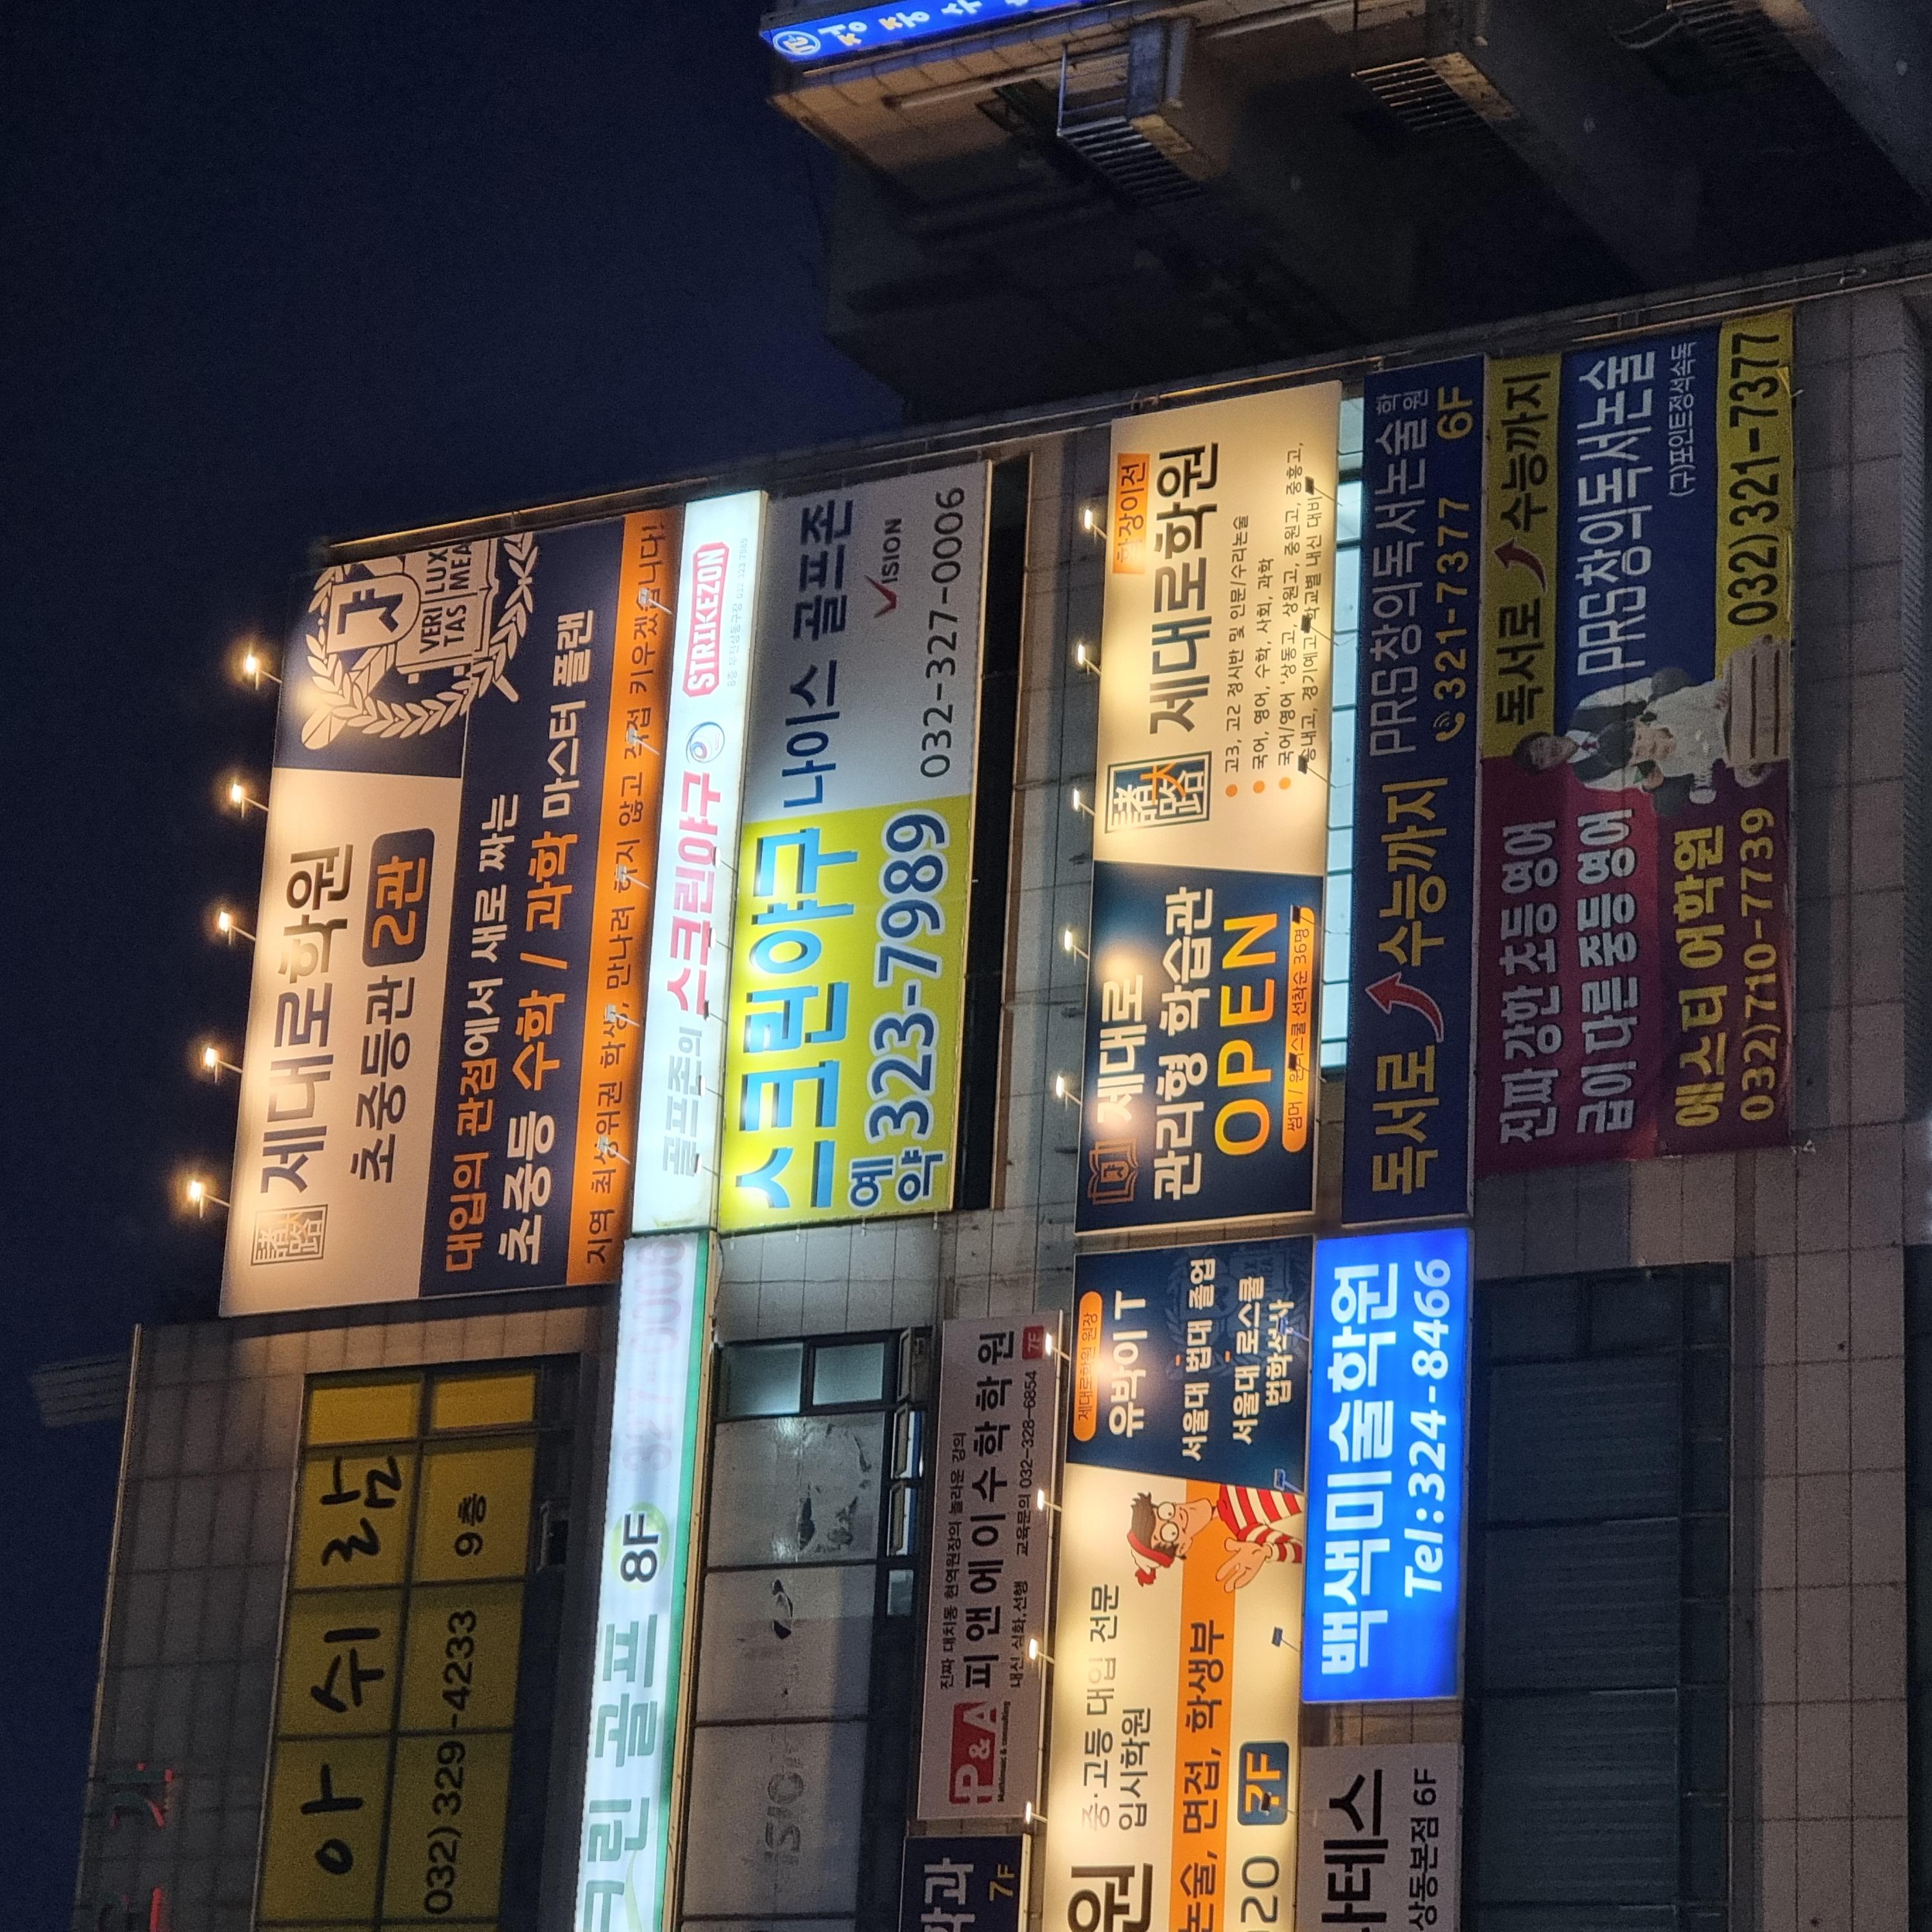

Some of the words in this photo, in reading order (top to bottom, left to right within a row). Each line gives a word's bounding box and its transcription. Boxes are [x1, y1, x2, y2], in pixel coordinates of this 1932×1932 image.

[1437, 386, 1474, 439] 6F
[1499, 371, 1550, 532] 수능까지
[1727, 333, 1781, 627] 032)321-7377
[1305, 534, 1323, 566] 내신
[1306, 495, 1324, 528] 대비
[1575, 351, 1656, 676] PRS창의독서논술
[424, 546, 448, 595] LUX
[451, 542, 473, 591] MEA
[792, 500, 853, 641] 골프존
[1147, 442, 1218, 735] 제대로학원
[1229, 515, 1249, 619] 인문/수리논술
[1257, 558, 1275, 589] 과학
[1282, 564, 1300, 617] 상원고,
[1433, 497, 1471, 701] 321-7377
[418, 607, 446, 654] VERI
[443, 605, 468, 647] TAS
[552, 610, 594, 686] 플랜
[684, 550, 726, 689] STRIKEZON
[920, 488, 965, 777] 032-327-0006
[1228, 626, 1246, 642] 및
[1256, 595, 1274, 633] 사회,
[1227, 649, 1244, 697] 정시반
[1255, 641, 1273, 679] 수학,
[1495, 598, 1545, 726] 독서로
[623, 708, 651, 760] 직접
[781, 660, 839, 808] 나이스
[1226, 704, 1242, 732] 고2
[1253, 685, 1271, 724] 영어,
[1278, 692, 1295, 766] 국어/영어
[542, 701, 586, 817] 마스터
[1225, 739, 1242, 773] 고3,
[1252, 732, 1270, 770] 국어,
[480, 794, 519, 871] 짜는
[618, 772, 644, 827] 않고
[526, 832, 577, 930] 과학
[613, 839, 640, 893] 하지
[1377, 777, 1449, 966] 수능까지
[1501, 819, 1558, 894] 영어
[1577, 808, 1636, 884] 영어
[371, 856, 426, 949] 2관
[470, 885, 508, 962] 새로
[666, 771, 721, 1015] 스크린야구
[1577, 893, 1638, 967] 중등
[1673, 825, 1725, 968] 어학원
[606, 906, 635, 989] 만나려
[867, 813, 945, 1139] 323-7989
[1160, 887, 1213, 1036] 학습관
[1293, 928, 1310, 964] 36명
[1499, 903, 1558, 974] 초등
[1739, 807, 1782, 1121] 032)710-7739
[260, 844, 353, 1193] 제대로학원
[735, 827, 858, 1209] 스크린야구
[1291, 970, 1308, 1016] 선착순
[1500, 985, 1563, 1060] 강한
[1581, 976, 1639, 1053] 다른
[458, 978, 502, 1136] 관점에서
[511, 990, 567, 1091] 수학
[1096, 974, 1146, 1123] 제대로
[1214, 912, 1278, 1156] OPEN
[1673, 985, 1728, 1127] 에스티
[351, 975, 414, 1183] 초중등관
[662, 1027, 702, 1176] 골프존의
[1286, 1101, 1303, 1132] 썸머
[1499, 1068, 1559, 1143] 진짜
[591, 1082, 622, 1193] 최상위권
[1154, 1053, 1208, 1200] 관리형
[1372, 1045, 1440, 1195] 독서로
[446, 1153, 488, 1272] 대입의
[499, 1111, 554, 1264] 초중등
[586, 1209, 614, 1264] 지역
[1113, 1290, 1147, 1320] T
[1188, 1257, 1217, 1310] 졸업
[1235, 1276, 1265, 1354] 로스쿨
[1080, 1312, 1098, 1342] 원장
[1184, 1320, 1213, 1372] 법대
[1076, 1346, 1096, 1421] 제대로학원
[1107, 1330, 1147, 1437] 유박이
[1182, 1382, 1210, 1461] 서울대
[1232, 1365, 1260, 1444] 서울대
[951, 1432, 966, 1463] 강의
[1020, 1370, 1038, 1488] 032-328-6854
[1404, 1259, 1451, 1598] Tel:324-8466
[948, 1469, 964, 1514] 놀라운
[1322, 1262, 1398, 1674] 백색미술학원
[455, 1492, 487, 1557] 9층
[620, 1512, 659, 1583] 8F
[962, 1330, 1014, 1689] 피앤에이수학학원
[1016, 1494, 1033, 1556] 교육문의
[943, 1521, 962, 1599] 현역원장의
[941, 1605, 958, 1652] 대치동
[1089, 1583, 1120, 1643] 전문
[299, 1457, 402, 1875] 아쉬람
[594, 1614, 657, 1767] 골프
[939, 1658, 954, 1690] 진짜
[1085, 1656, 1116, 1715] 대입
[1186, 1619, 1224, 1732] 학생부
[1118, 1707, 1151, 1830] 입시학원
[1182, 1747, 1222, 1833] 면접,
[1413, 1768, 1437, 1807] 6F
[989, 1864, 1014, 1901] 7F
[1067, 1863, 1153, 1932] 원
[1408, 1817, 1438, 1931] 상동본점
